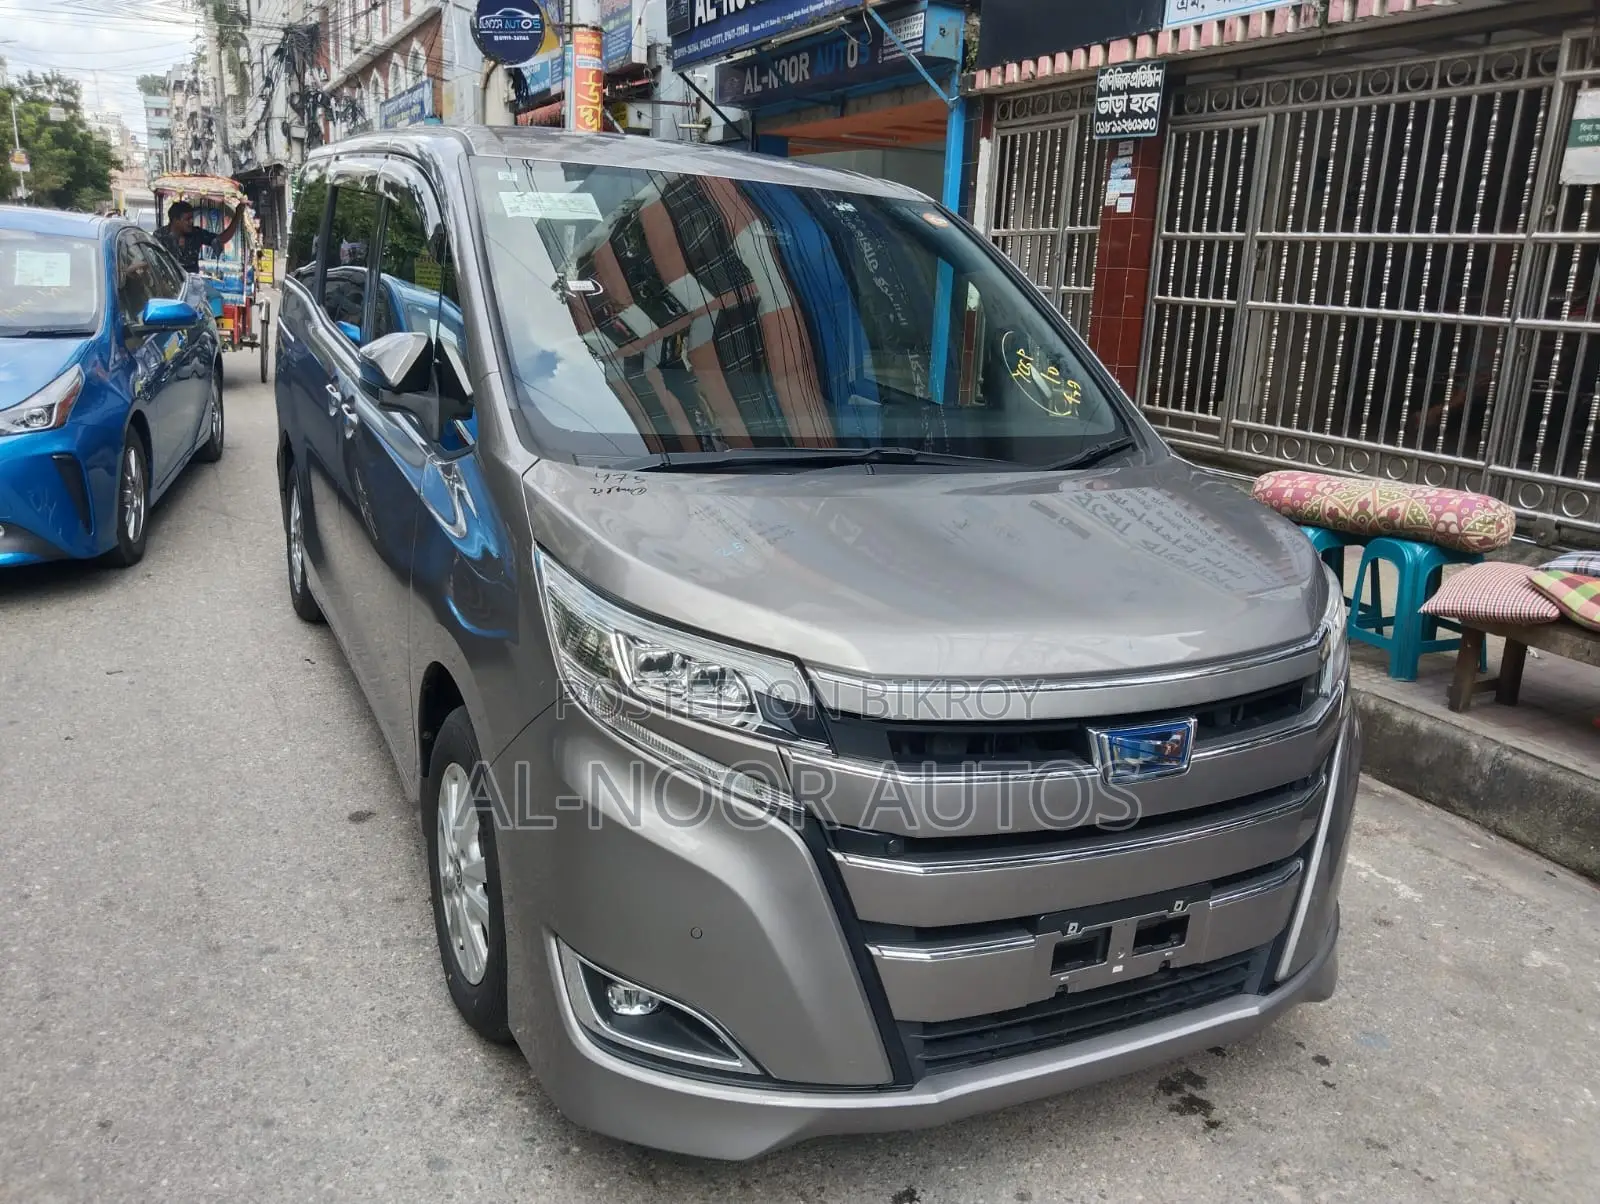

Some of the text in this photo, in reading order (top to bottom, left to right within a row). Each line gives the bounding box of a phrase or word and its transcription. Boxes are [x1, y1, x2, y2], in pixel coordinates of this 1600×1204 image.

[504, 18, 541, 30] AUTOS
[743, 52, 810, 95] AL-NOOR
[1097, 92, 1160, 118] ভাড়া হবে
